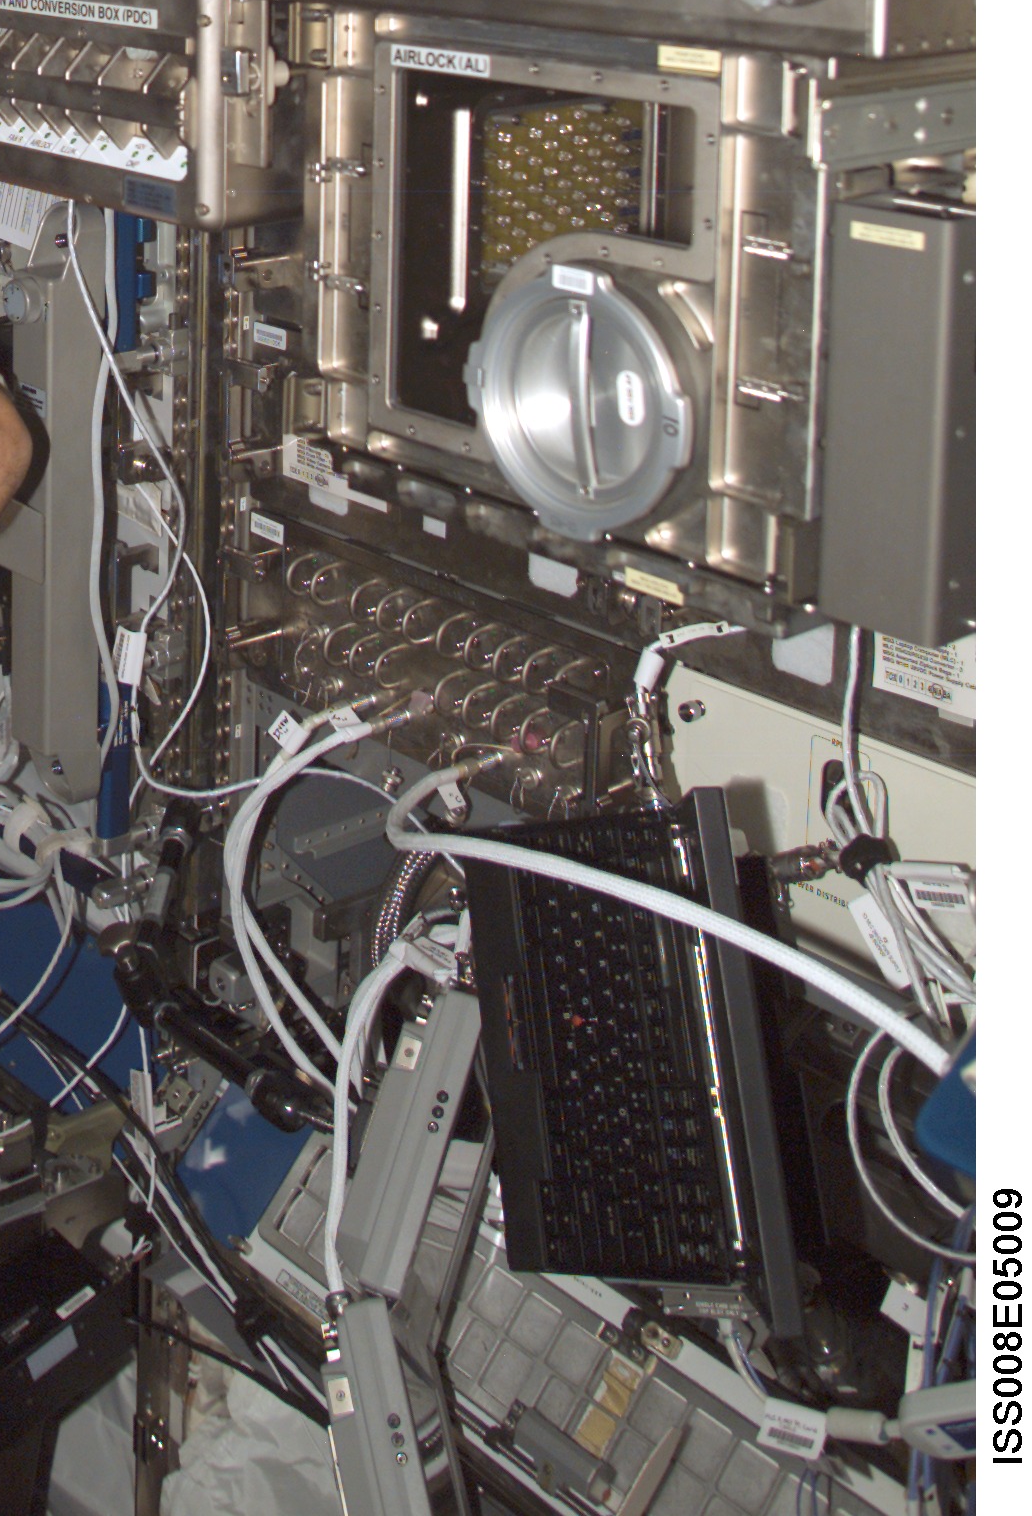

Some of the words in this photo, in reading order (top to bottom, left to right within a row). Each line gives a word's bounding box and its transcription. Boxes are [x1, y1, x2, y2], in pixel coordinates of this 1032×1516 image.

[98, 5, 119, 21] BOX
[122, 9, 153, 25] (PDC)
[393, 48, 457, 70] AIRLOCK
[458, 52, 488, 75] (AL)
